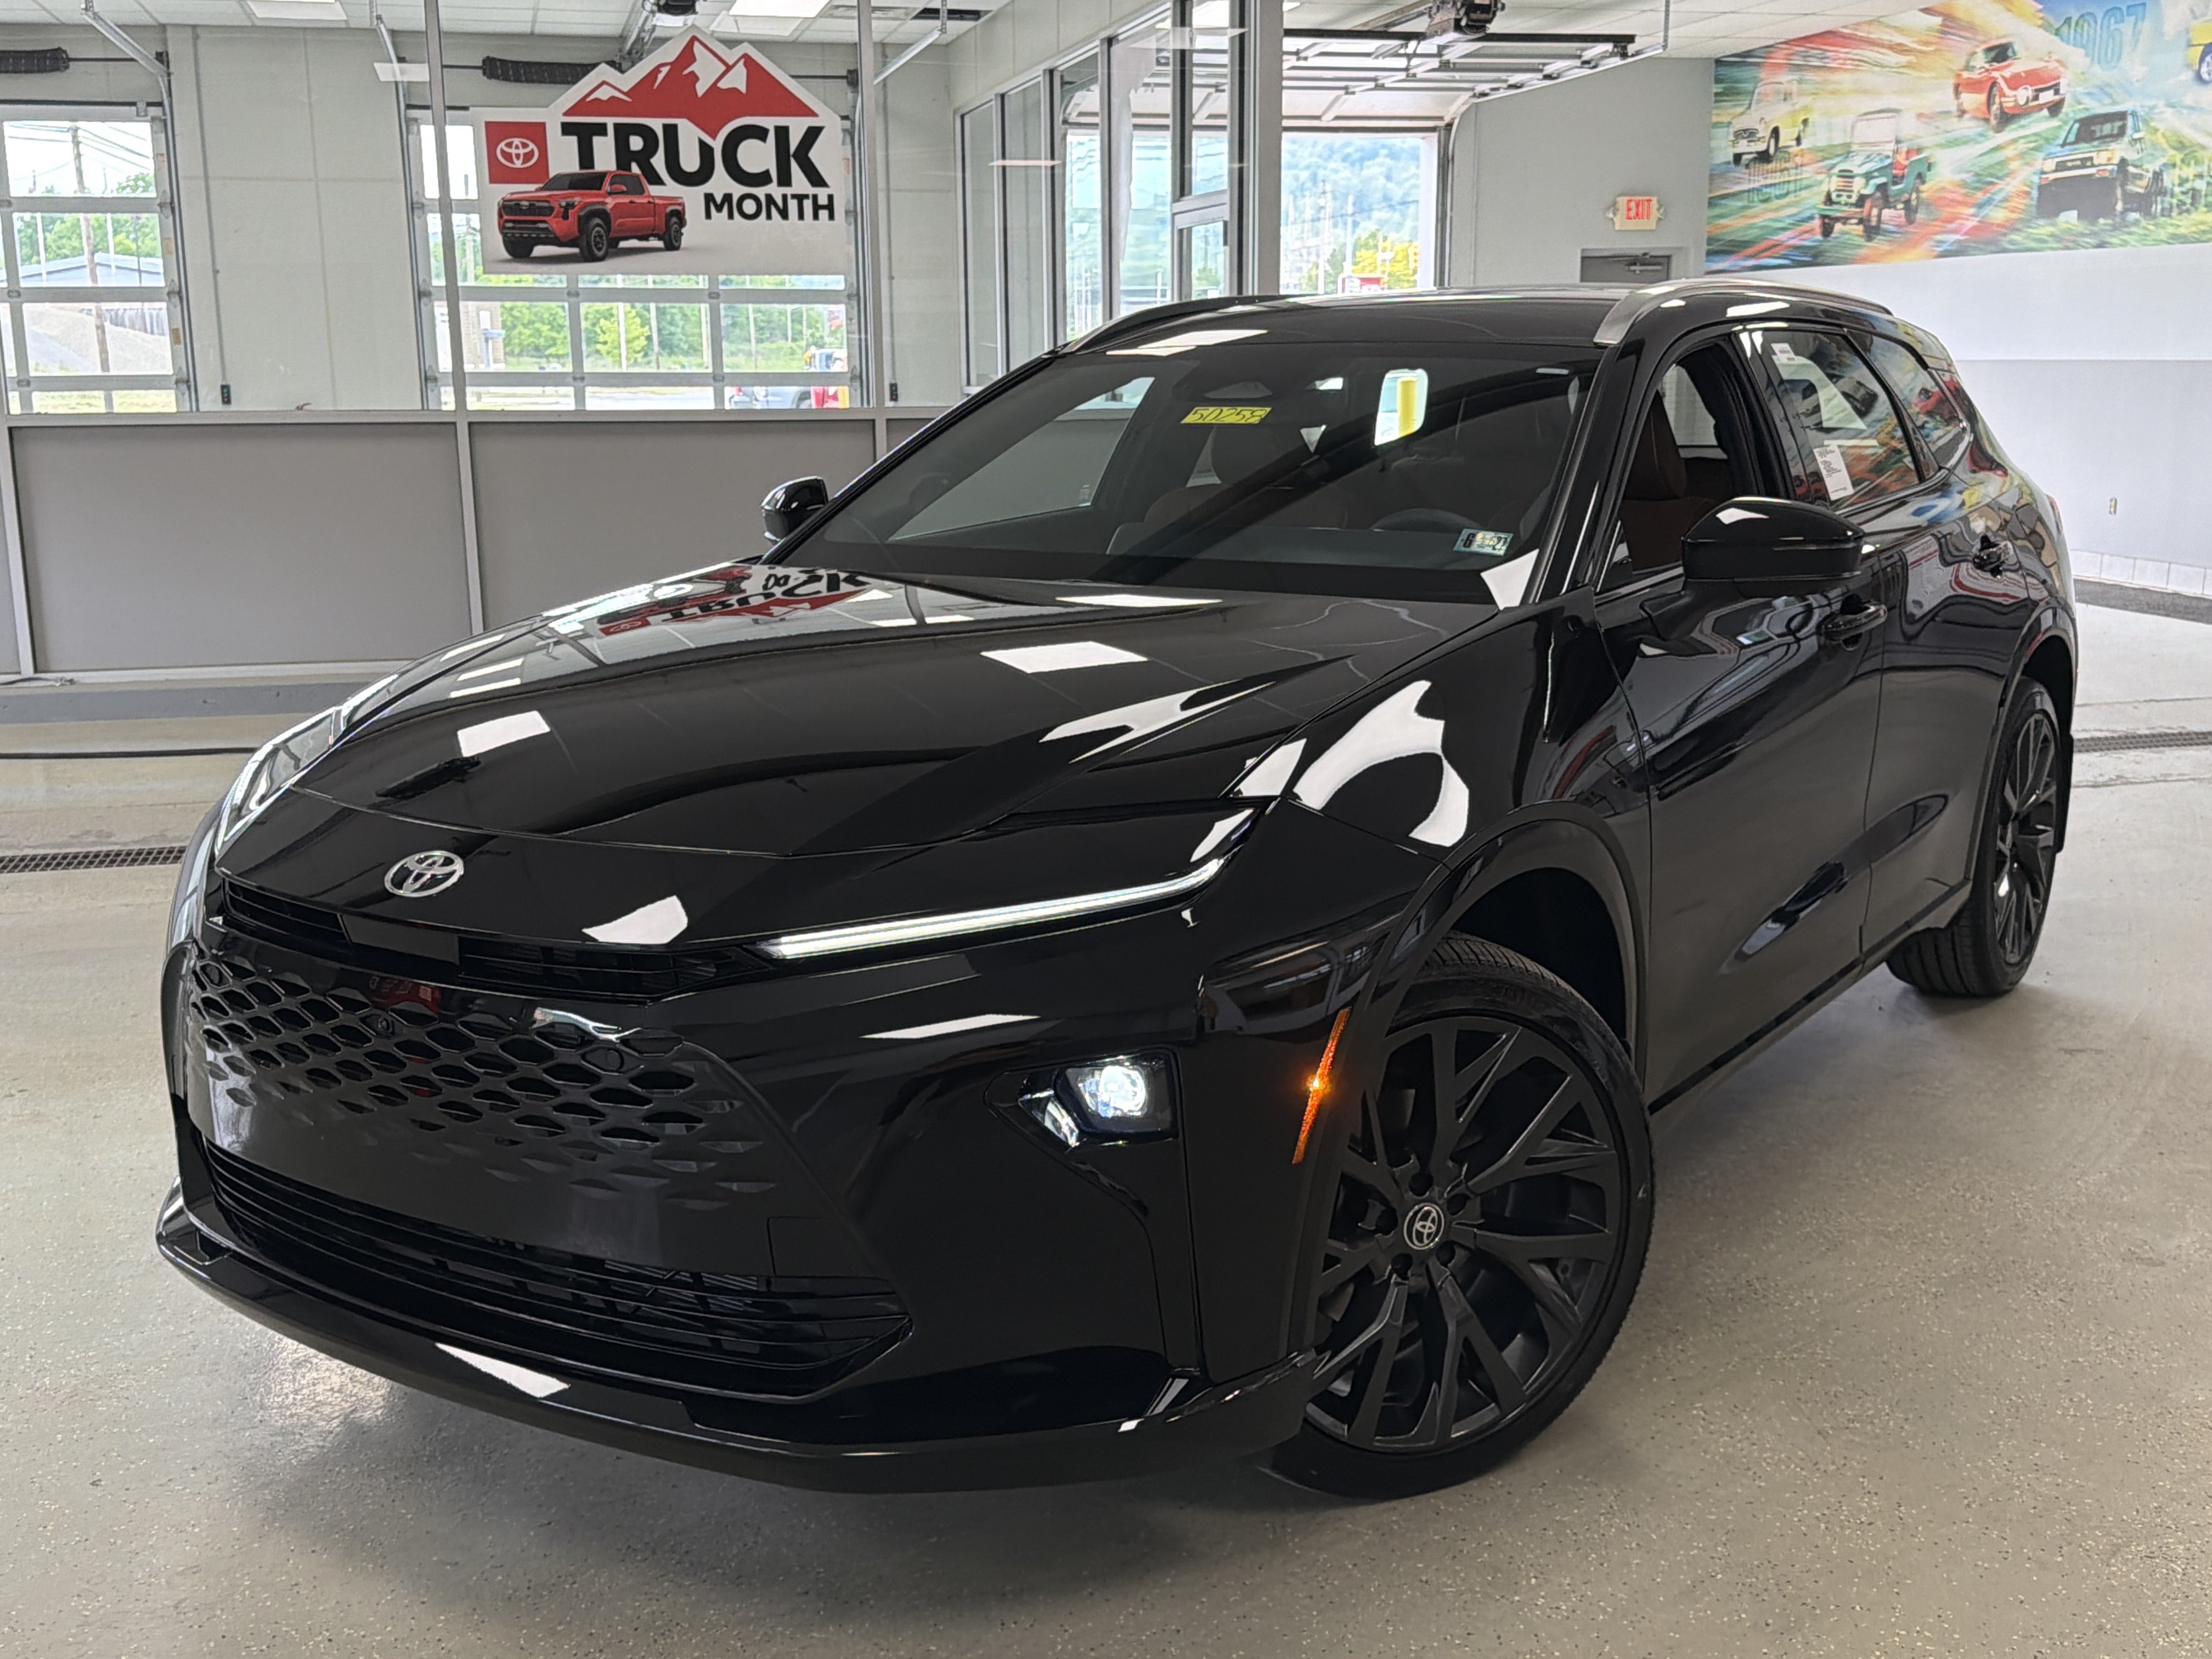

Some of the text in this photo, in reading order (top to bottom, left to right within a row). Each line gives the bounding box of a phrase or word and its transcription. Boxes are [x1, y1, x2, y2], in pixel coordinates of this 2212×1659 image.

[2054, 2, 2147, 72] 1967
[561, 121, 830, 189] TRUCK
[704, 192, 836, 222] MONTH
[1626, 199, 1652, 220] EXIT
[1463, 533, 1477, 548] 6
